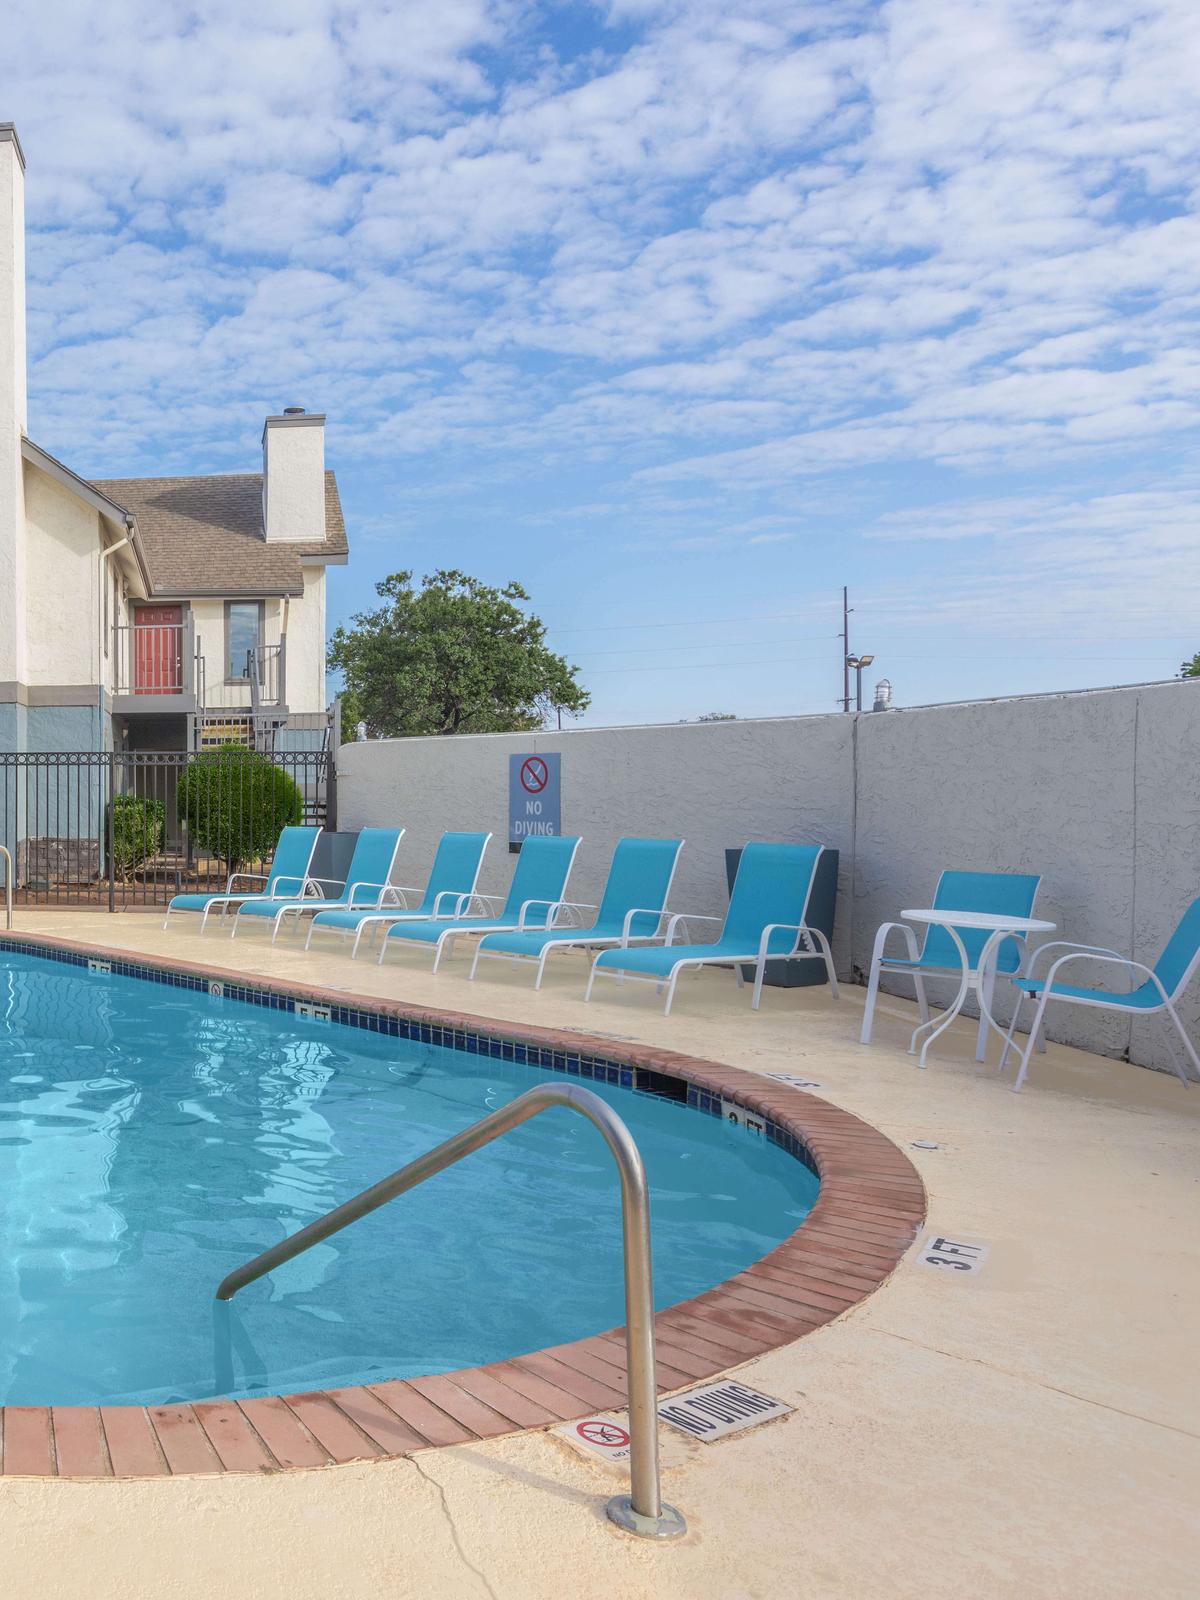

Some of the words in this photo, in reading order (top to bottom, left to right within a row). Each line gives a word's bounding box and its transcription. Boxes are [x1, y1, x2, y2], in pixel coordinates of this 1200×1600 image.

[525, 801, 542, 816] NO
[514, 821, 554, 836] DIVING
[931, 1237, 982, 1259] FT
[925, 1256, 972, 1271] 3
[684, 1385, 779, 1424] DIVING
[657, 1405, 717, 1434] NO
